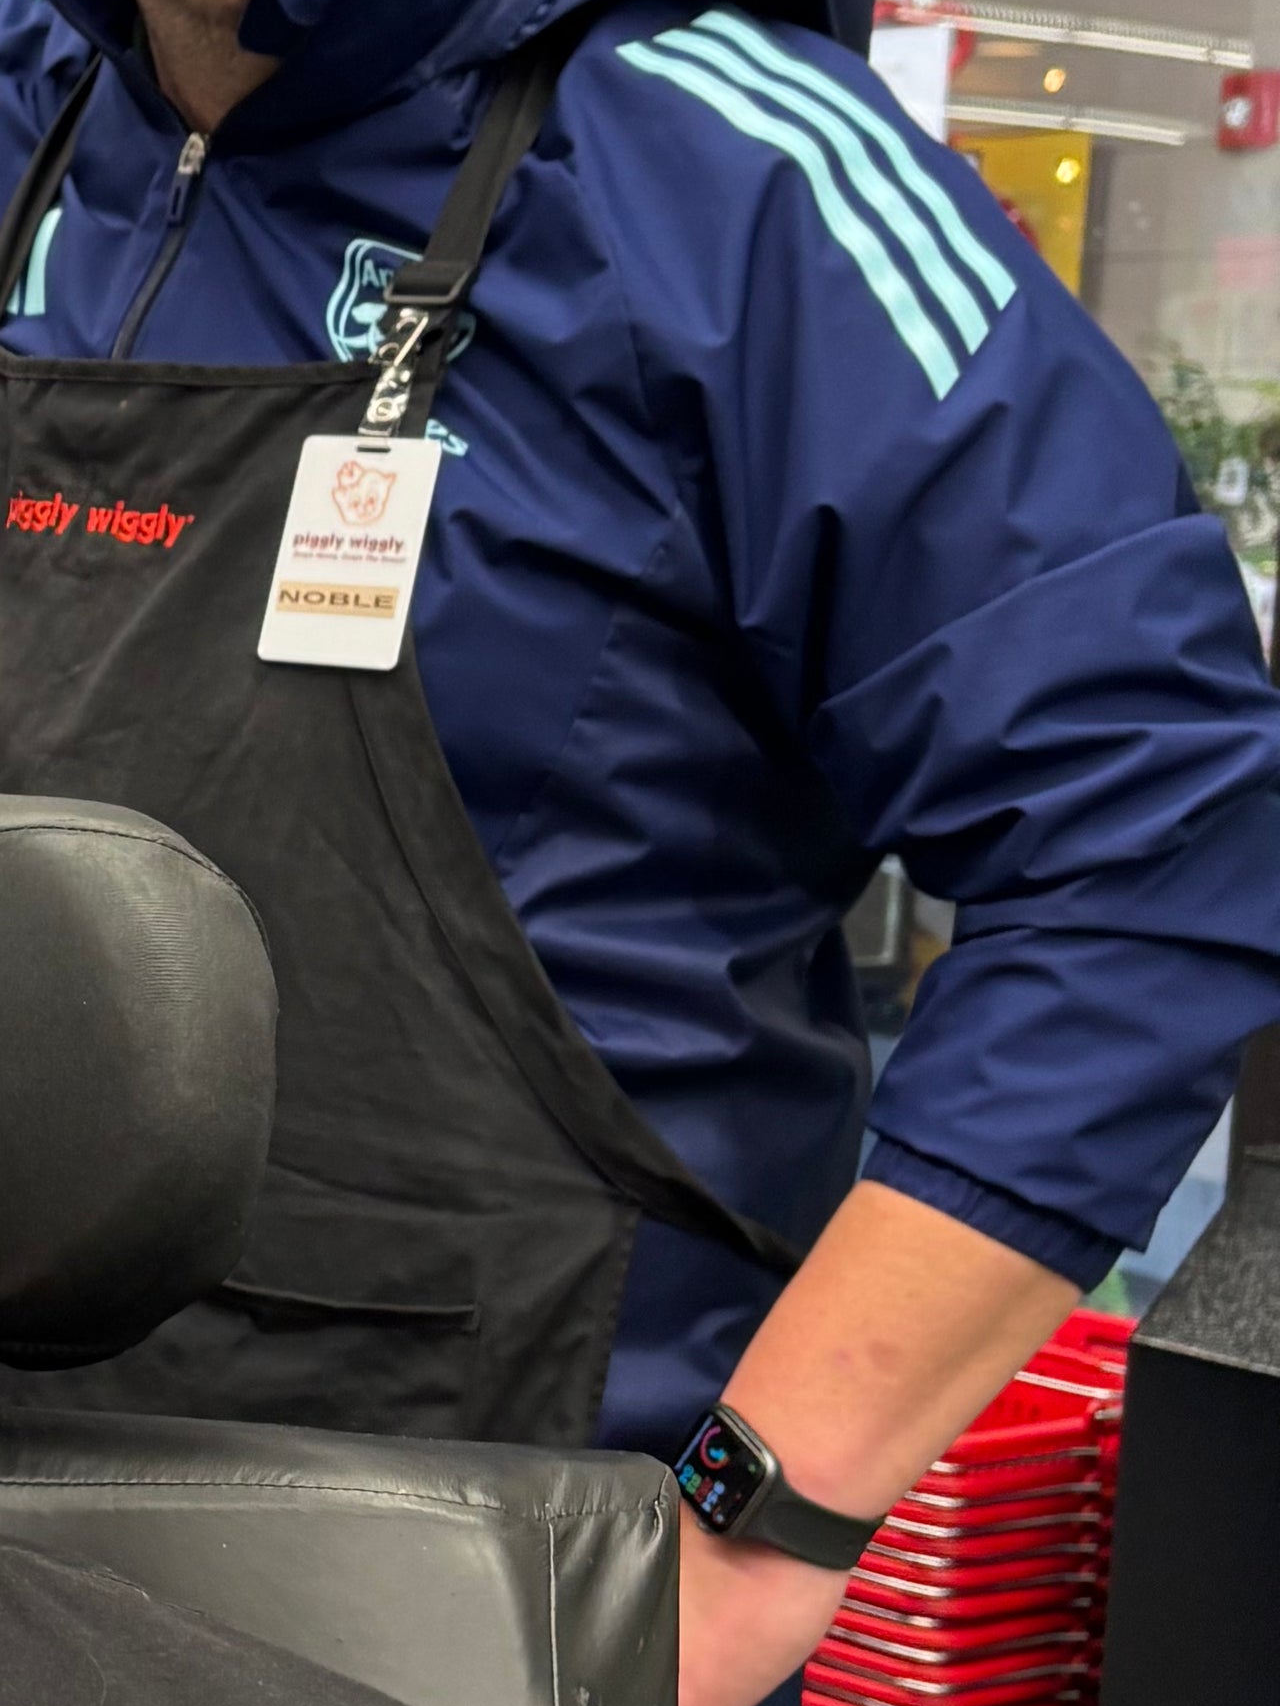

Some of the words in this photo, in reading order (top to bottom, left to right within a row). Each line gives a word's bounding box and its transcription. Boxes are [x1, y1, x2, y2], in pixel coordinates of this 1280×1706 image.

[86, 500, 186, 549] wiggly
[293, 531, 344, 551] piggly
[349, 534, 404, 555] wiggly
[278, 589, 393, 610] NOBLE
